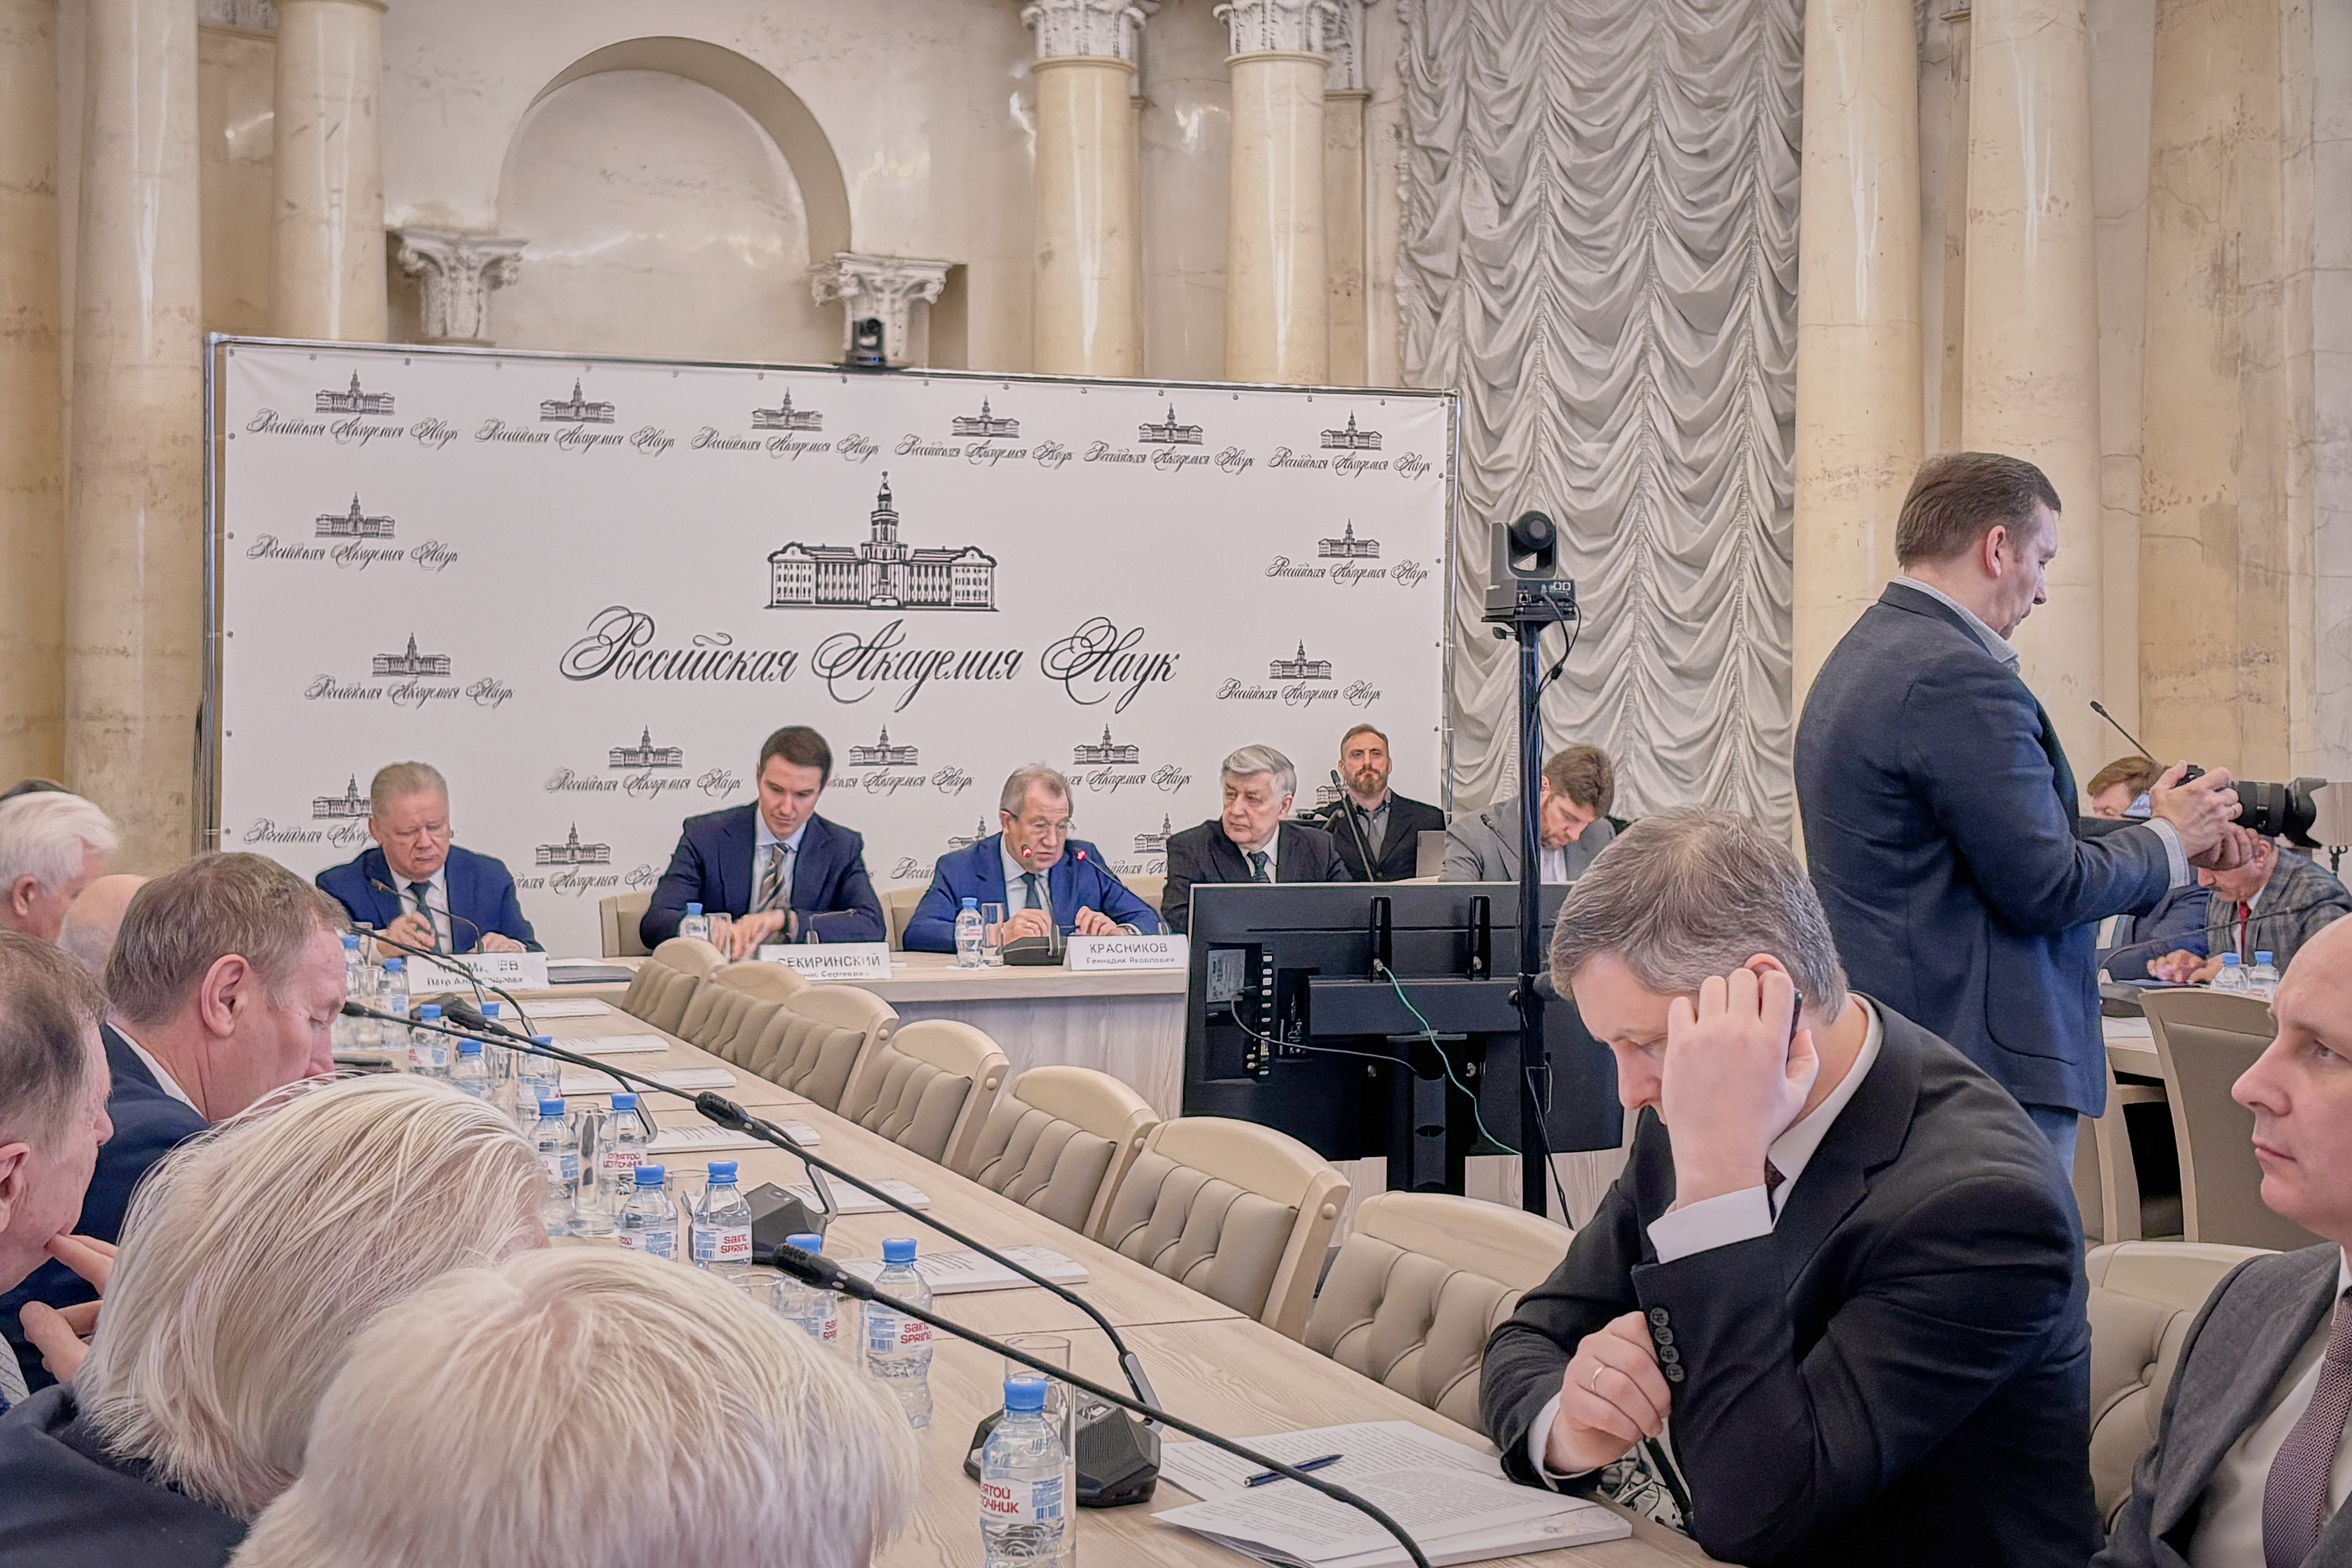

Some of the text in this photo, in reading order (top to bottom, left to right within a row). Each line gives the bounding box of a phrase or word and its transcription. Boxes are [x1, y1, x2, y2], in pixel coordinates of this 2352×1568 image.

[560, 605, 1180, 715] Российская Академия Наук
[1089, 943, 1168, 954] КРАСНИКОВ
